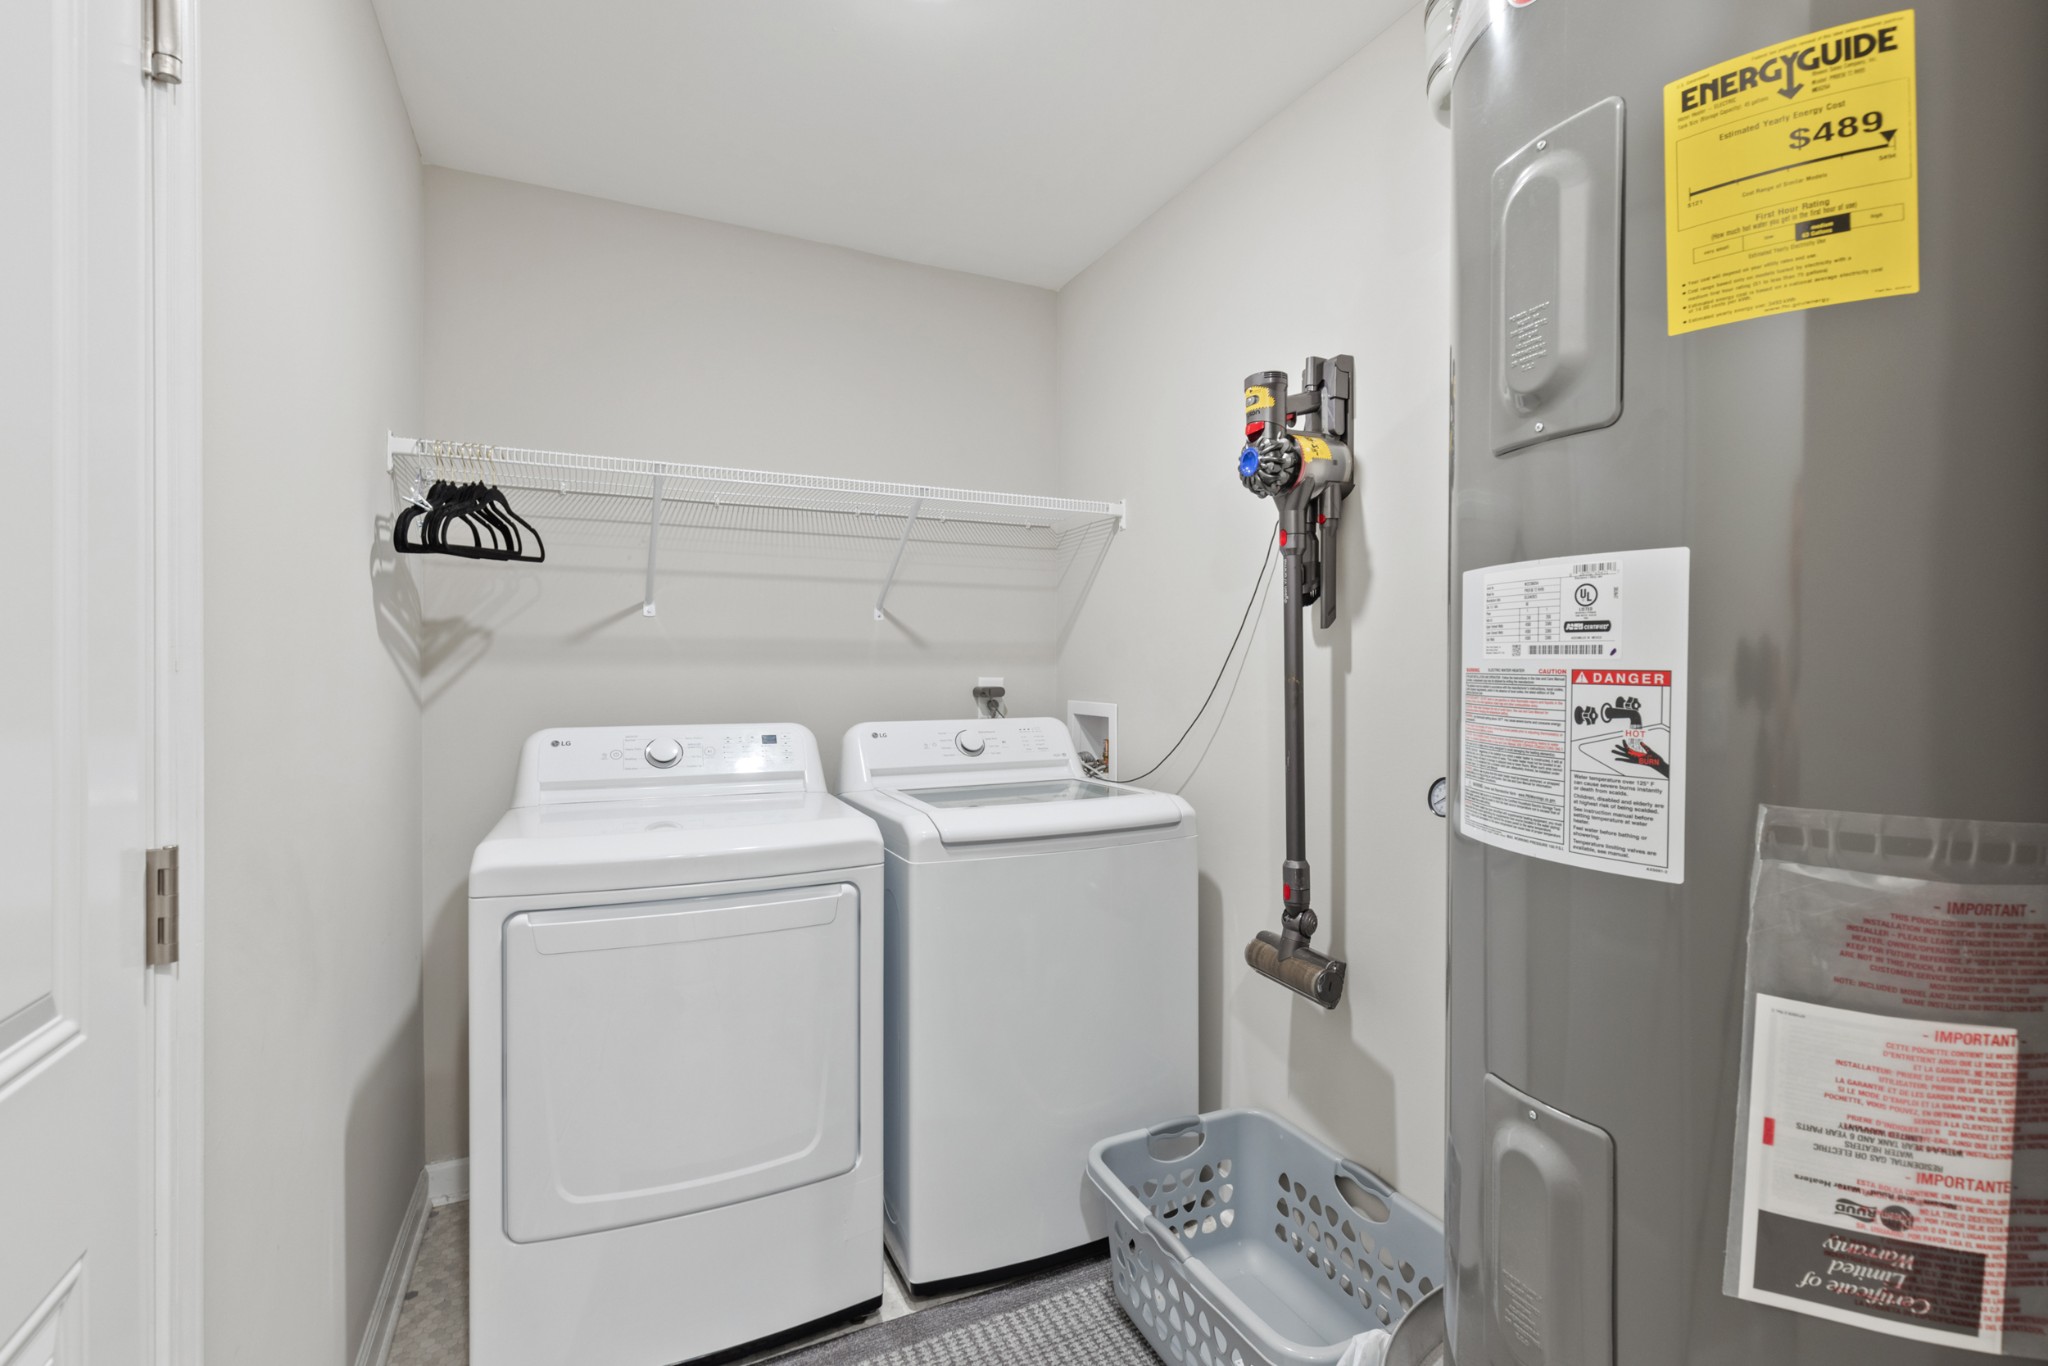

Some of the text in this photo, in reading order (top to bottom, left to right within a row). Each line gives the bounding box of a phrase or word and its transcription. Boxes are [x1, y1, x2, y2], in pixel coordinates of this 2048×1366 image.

[1681, 26, 1898, 113] ENERGYGUIDE
[1719, 100, 1846, 141] Estimated Yearly Energy Cost
[1788, 110, 1884, 150] $489
[1755, 198, 1830, 221] First Hour Rating
[1580, 588, 1592, 602] UL
[1593, 672, 1664, 684] DANGER
[1625, 730, 1646, 738] HOT
[1588, 775, 1621, 784] temperature
[1636, 787, 1662, 795] instantly
[1583, 808, 1611, 816] instruction
[1591, 815, 1623, 824] temperature
[1617, 832, 1640, 840] bathing
[1947, 902, 2028, 916] IMPORTANT
[1863, 918, 1920, 932] INSTALLATION
[1890, 913, 1909, 922] THIS
[1912, 916, 1940, 925] POUCH
[1846, 924, 1888, 936] INSTALLER
[1898, 932, 1927, 942] PLEASE
[1845, 942, 1866, 950] KEEP
[1868, 945, 1884, 954] FOR
[1840, 950, 1855, 958] ARE
[1857, 953, 1872, 961] NOT
[1887, 958, 1904, 967] THIS
[1870, 964, 1947, 981] CUSTOMER SERVICE
[1858, 981, 1898, 993] INCLUDED
[1900, 988, 1926, 997] MODEL
[1902, 998, 1925, 1006] NAME
[1935, 1031, 2018, 1047] IMPORTANT
[1886, 1042, 1909, 1051] CETTE
[1796, 1122, 1823, 1135] PARTS
[1825, 1127, 1847, 1139] YEAR
[1858, 1135, 1875, 1144] AND
[1878, 1138, 1898, 1148] TANK
[1844, 1140, 1913, 1158] WATER HEATERS
[1812, 1143, 1943, 1173] RESIDENTIAL GAS OR ELECTRIC
[1794, 1174, 1831, 1188] Heaters
[1917, 1172, 2012, 1194] IMPORTANTE
[1835, 1204, 1877, 1218] RUUD
[1822, 1235, 1915, 1270] Warranty
[1827, 1260, 1905, 1288] Limited
[1795, 1272, 1930, 1314] Certificate of
